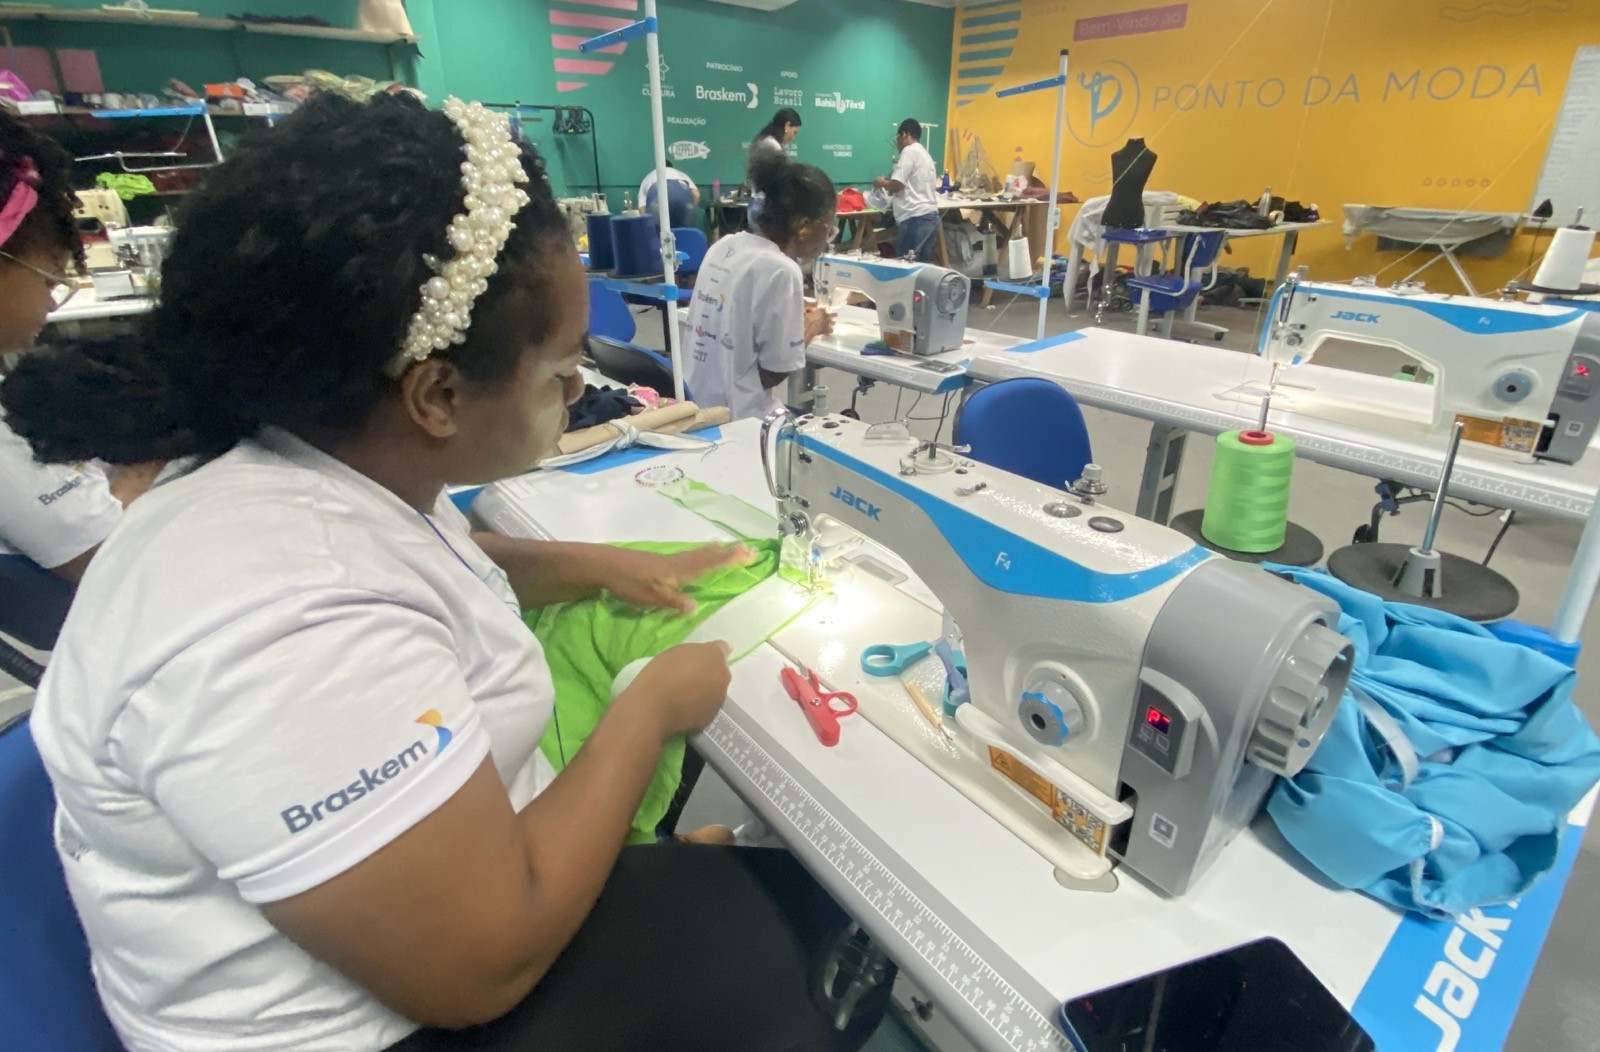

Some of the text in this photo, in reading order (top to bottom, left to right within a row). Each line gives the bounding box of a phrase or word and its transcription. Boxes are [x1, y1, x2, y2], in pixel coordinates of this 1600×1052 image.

[642, 88, 676, 98] CUURA
[696, 85, 746, 102] Braskem
[774, 87, 803, 97] Lavoro
[1152, 63, 1543, 113] PONTO DA MODA
[774, 96, 802, 106] Brasil
[667, 116, 706, 126] REALIZAÇÃO
[38, 476, 81, 506] Braske
[280, 740, 429, 834] Braskem
